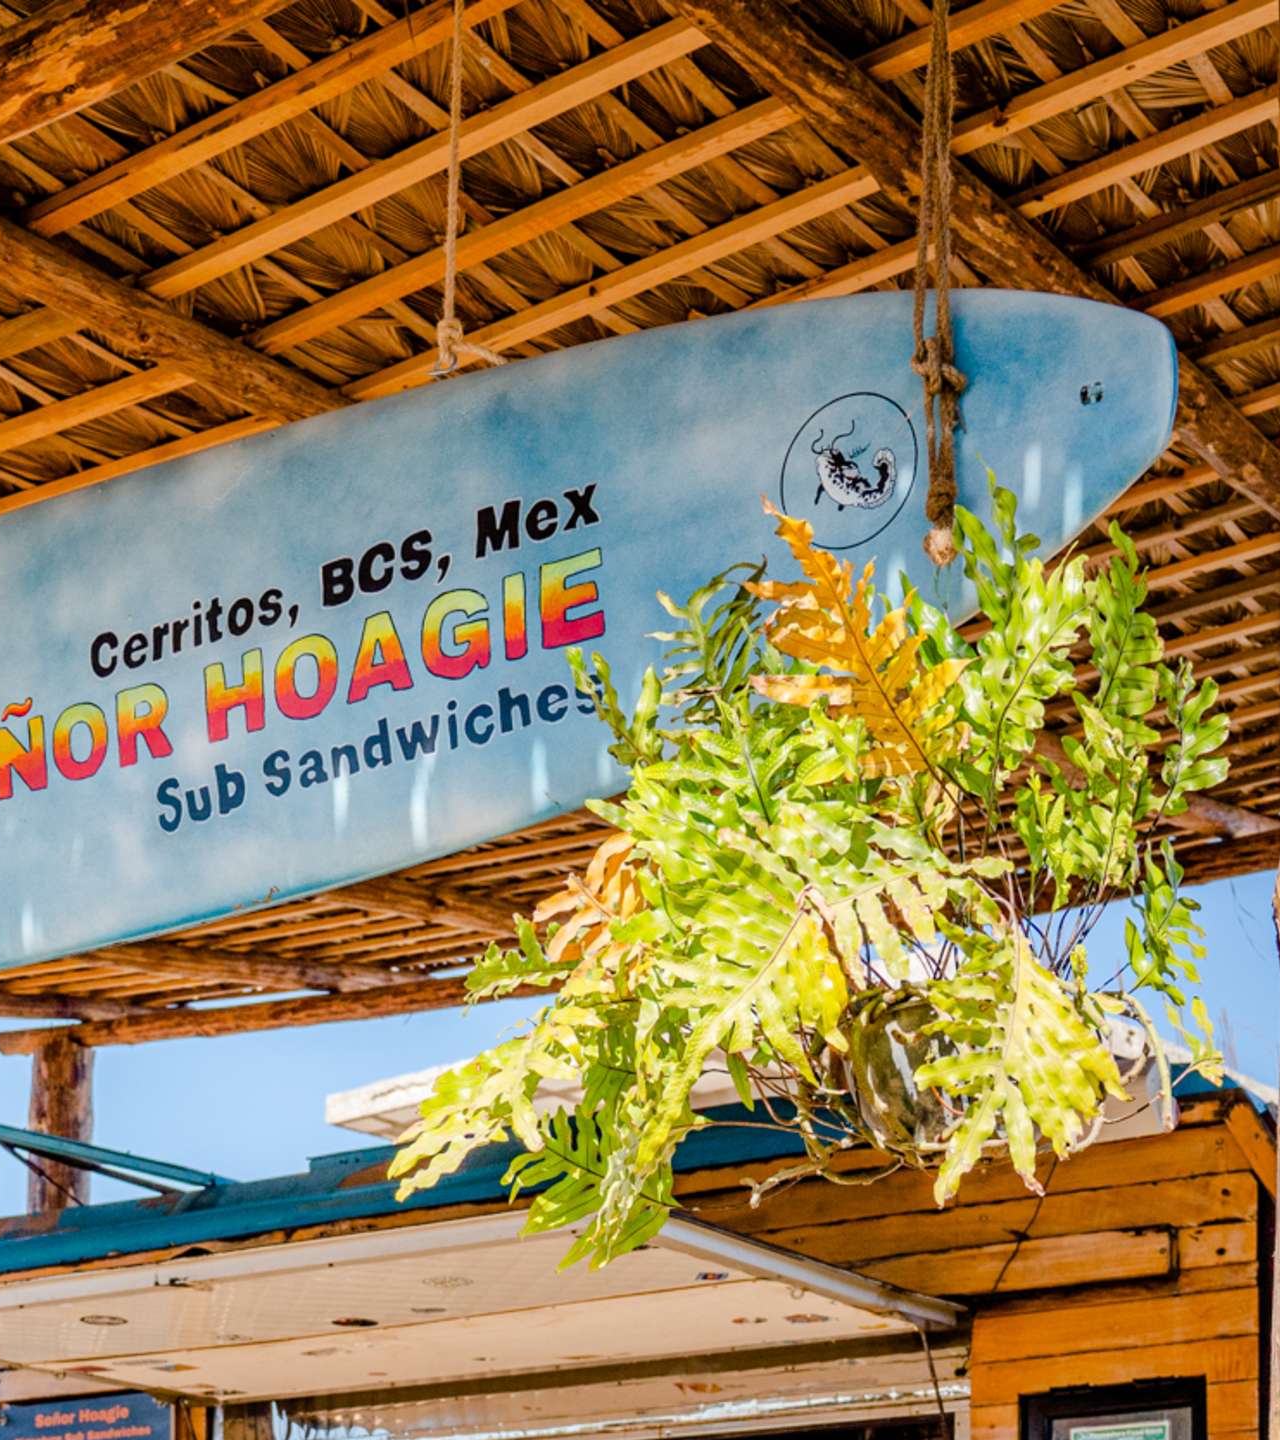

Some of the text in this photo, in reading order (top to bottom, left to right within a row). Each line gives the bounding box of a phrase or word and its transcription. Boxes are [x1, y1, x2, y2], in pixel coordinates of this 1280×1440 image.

[89, 483, 600, 678] Cerritos, BCS, Mex
[203, 547, 607, 744] HOAGIE
[156, 673, 604, 832] Sub Sandwiches
[34, 1404, 129, 1428] Señor Hoagie
[87, 1426, 152, 1440] Sandwiches
